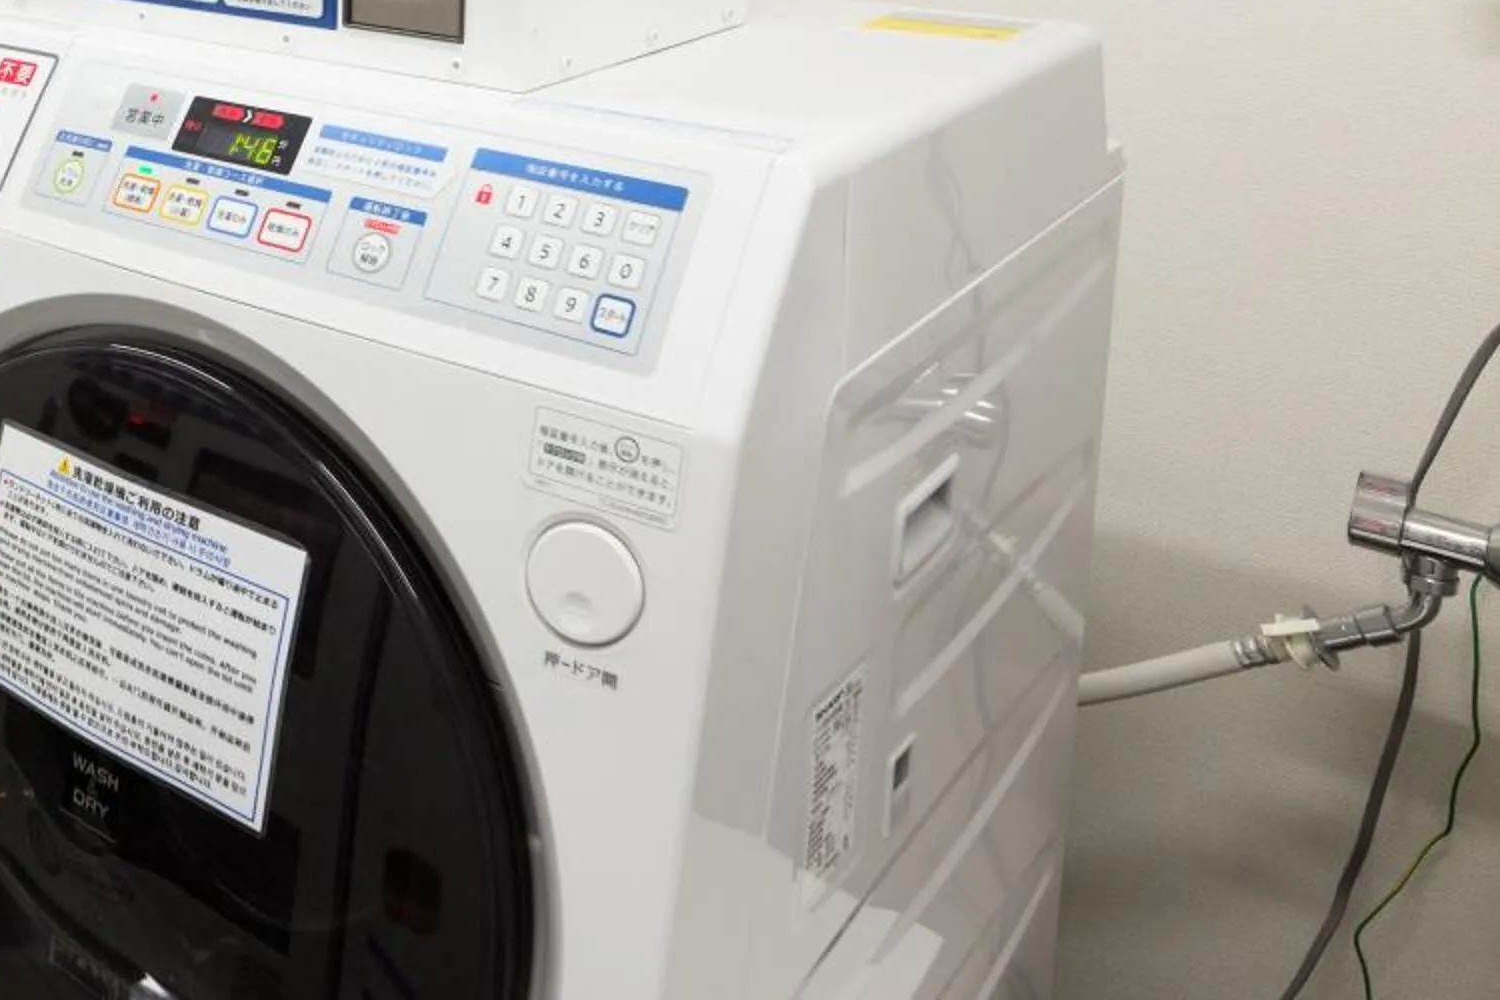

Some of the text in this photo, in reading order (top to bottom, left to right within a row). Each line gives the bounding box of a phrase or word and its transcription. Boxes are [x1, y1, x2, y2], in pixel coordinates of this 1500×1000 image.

[518, 195, 526, 209] 1
[552, 203, 565, 219] 2
[594, 211, 605, 227] 3
[500, 236, 513, 249] 4
[540, 244, 552, 260] 5
[579, 253, 590, 269] 6
[619, 263, 633, 279] 0
[488, 276, 500, 291] 7
[524, 285, 537, 303] 8
[565, 297, 577, 313] 9
[73, 751, 119, 792] WASH
[73, 788, 110, 819] DRY
